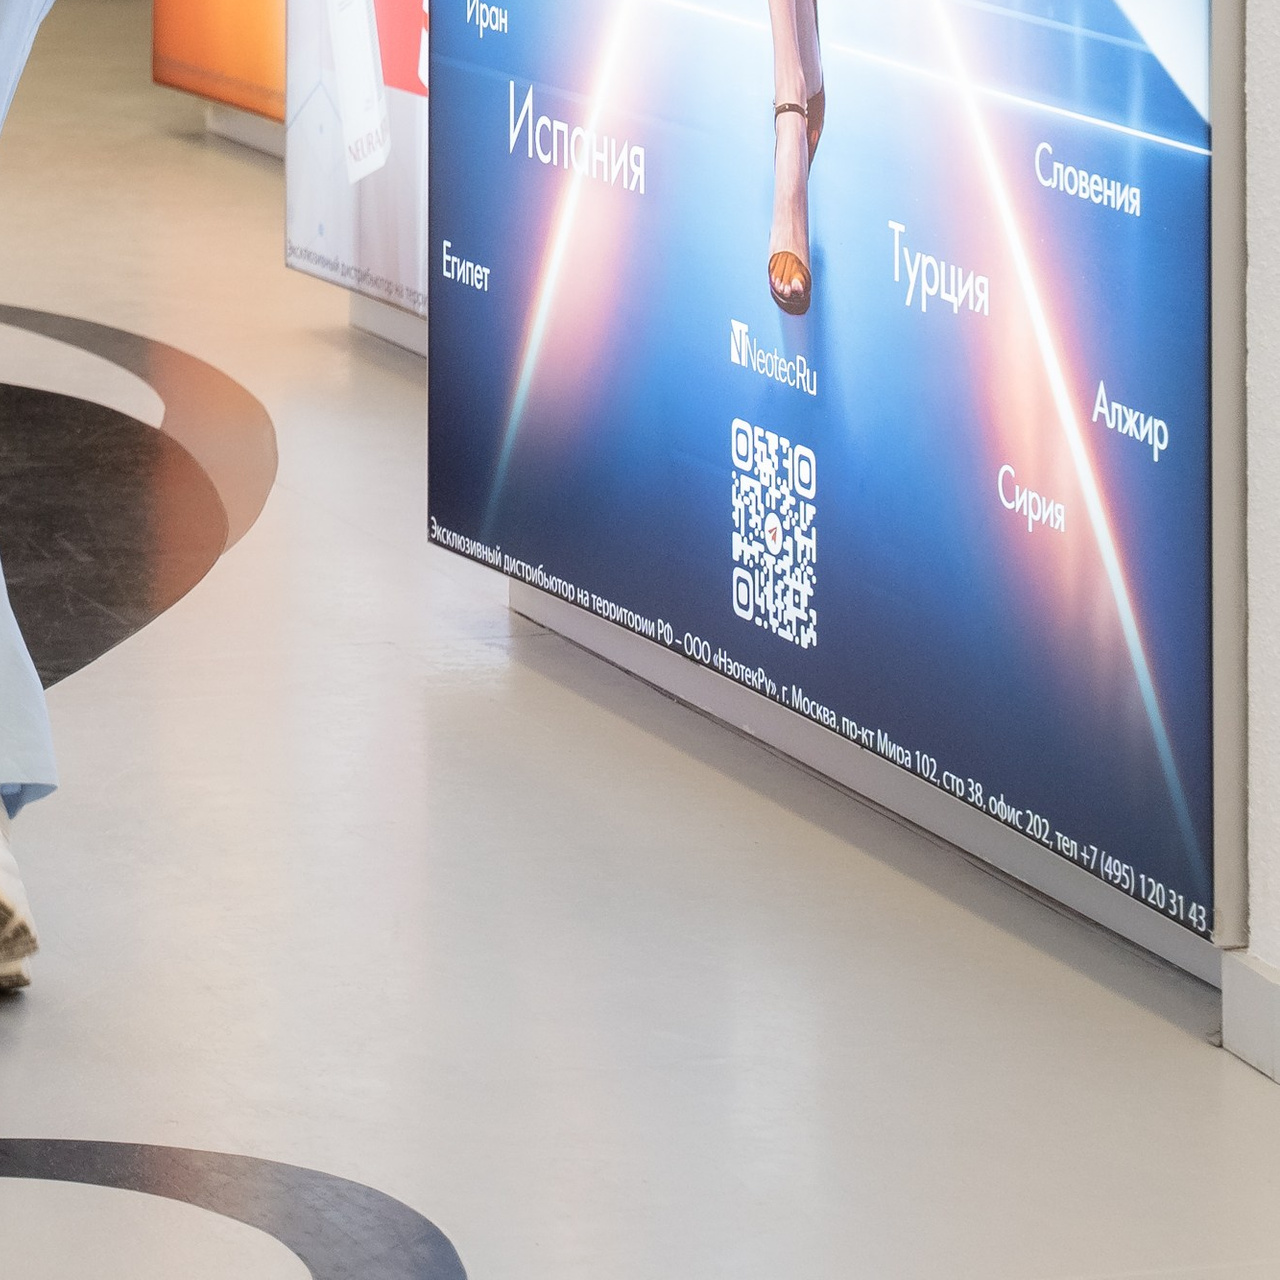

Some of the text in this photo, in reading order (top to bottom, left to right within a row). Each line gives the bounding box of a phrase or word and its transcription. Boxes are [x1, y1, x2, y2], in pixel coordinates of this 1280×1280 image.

[509, 80, 645, 195] Испания
[1035, 142, 1141, 218] Словения
[443, 240, 490, 293] Египет
[888, 221, 990, 316] Турция
[745, 334, 817, 396] NeotecRu
[1093, 381, 1169, 463] Алжир
[998, 464, 1065, 533] Сирия
[430, 516, 502, 568] Эксклюзивный
[503, 554, 574, 604] дистрибьютор
[577, 589, 589, 607] на
[591, 593, 655, 638] территории
[657, 618, 673, 646] РФ
[684, 632, 710, 664] ООО
[713, 648, 780, 702] «НэотекРу»,
[781, 686, 789, 704] г.
[792, 685, 840, 731] Москва,
[842, 716, 875, 748] пр-кт
[877, 728, 912, 769] Мира
[915, 750, 940, 786] 102,
[943, 770, 965, 797] стр
[967, 778, 986, 811] 38,
[988, 793, 1023, 830] офис
[1025, 809, 1053, 849] 202,
[1055, 831, 1078, 861] тел
[1080, 844, 1097, 870] +7
[1100, 851, 1135, 896] (495)
[1139, 873, 1165, 909] 120
[1169, 889, 1184, 920] 31
[1188, 902, 1206, 932] 43
